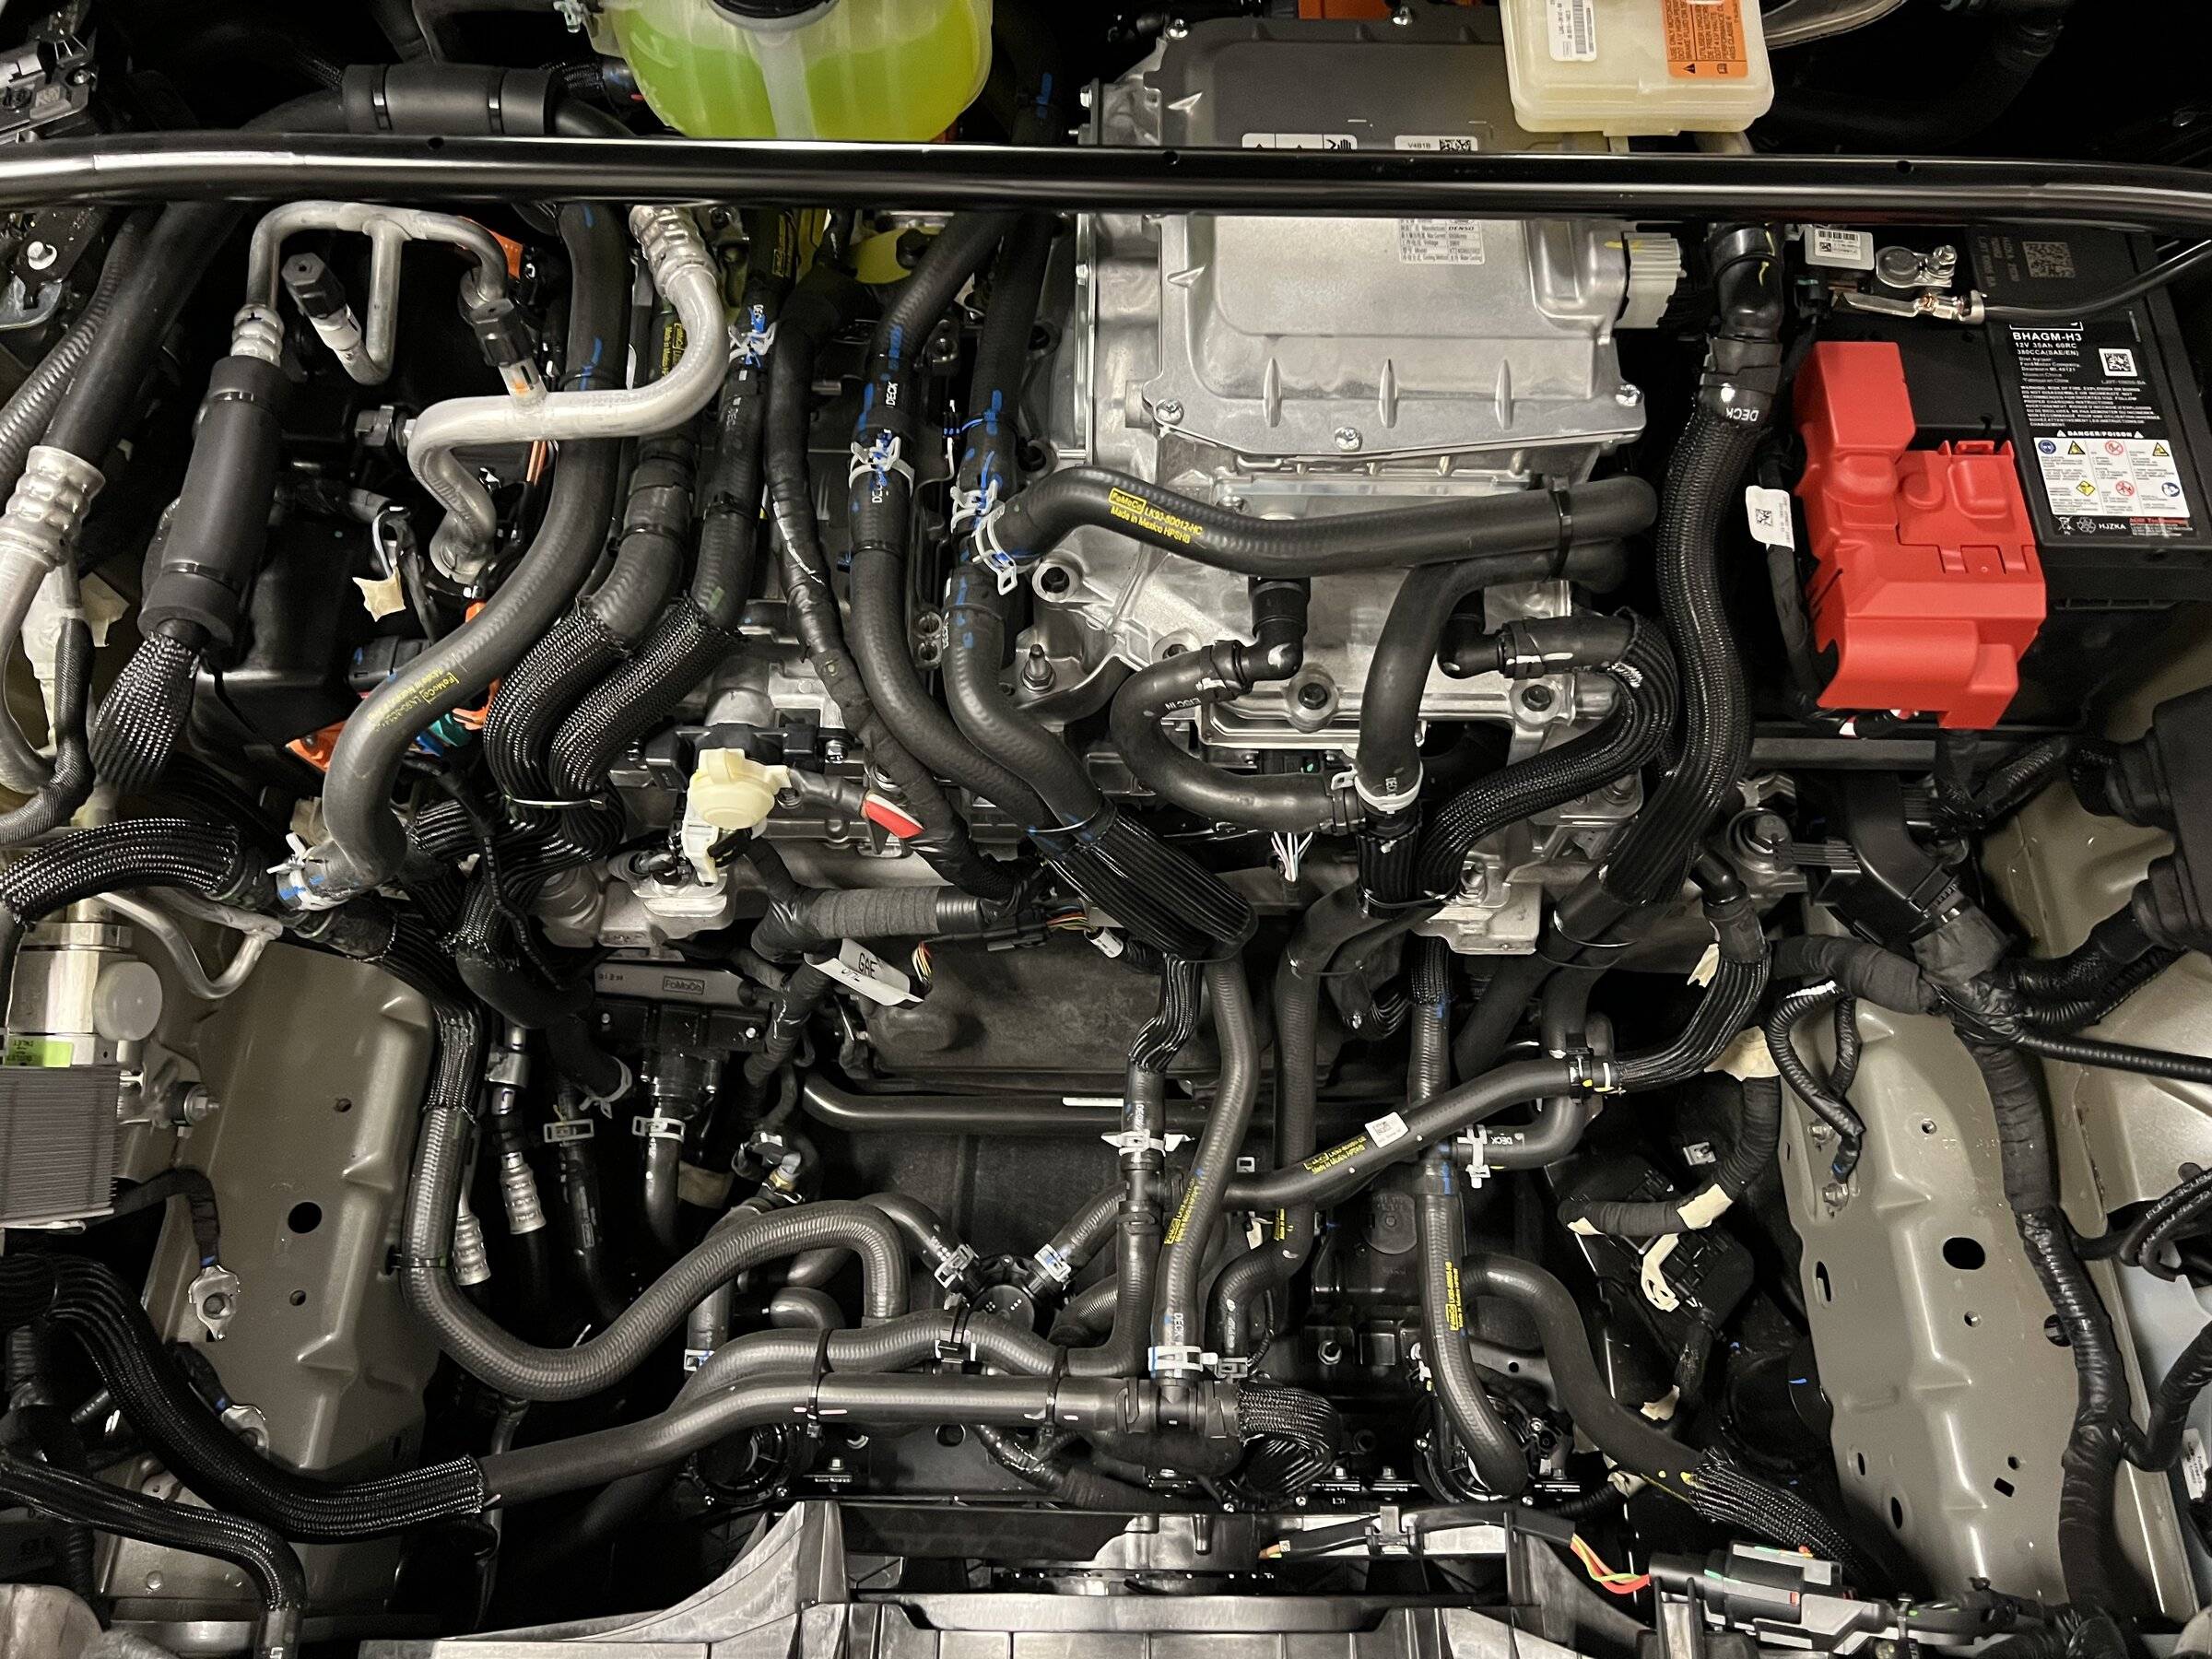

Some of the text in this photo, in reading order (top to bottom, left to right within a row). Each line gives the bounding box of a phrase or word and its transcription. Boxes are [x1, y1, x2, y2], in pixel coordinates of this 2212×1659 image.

[2012, 332, 2083, 341] BHAGM-H3
[885, 381, 898, 406] DECK
[1726, 407, 1759, 422] DECK
[1111, 491, 1144, 512] FoMoCo
[1110, 506, 1130, 521] Made
[1138, 516, 1163, 534] Mexico
[424, 675, 454, 698] FoMoCo
[665, 979, 703, 991] FoMoCo
[1491, 1136, 1513, 1145] DECK
[1174, 1312, 1184, 1337] DECK
